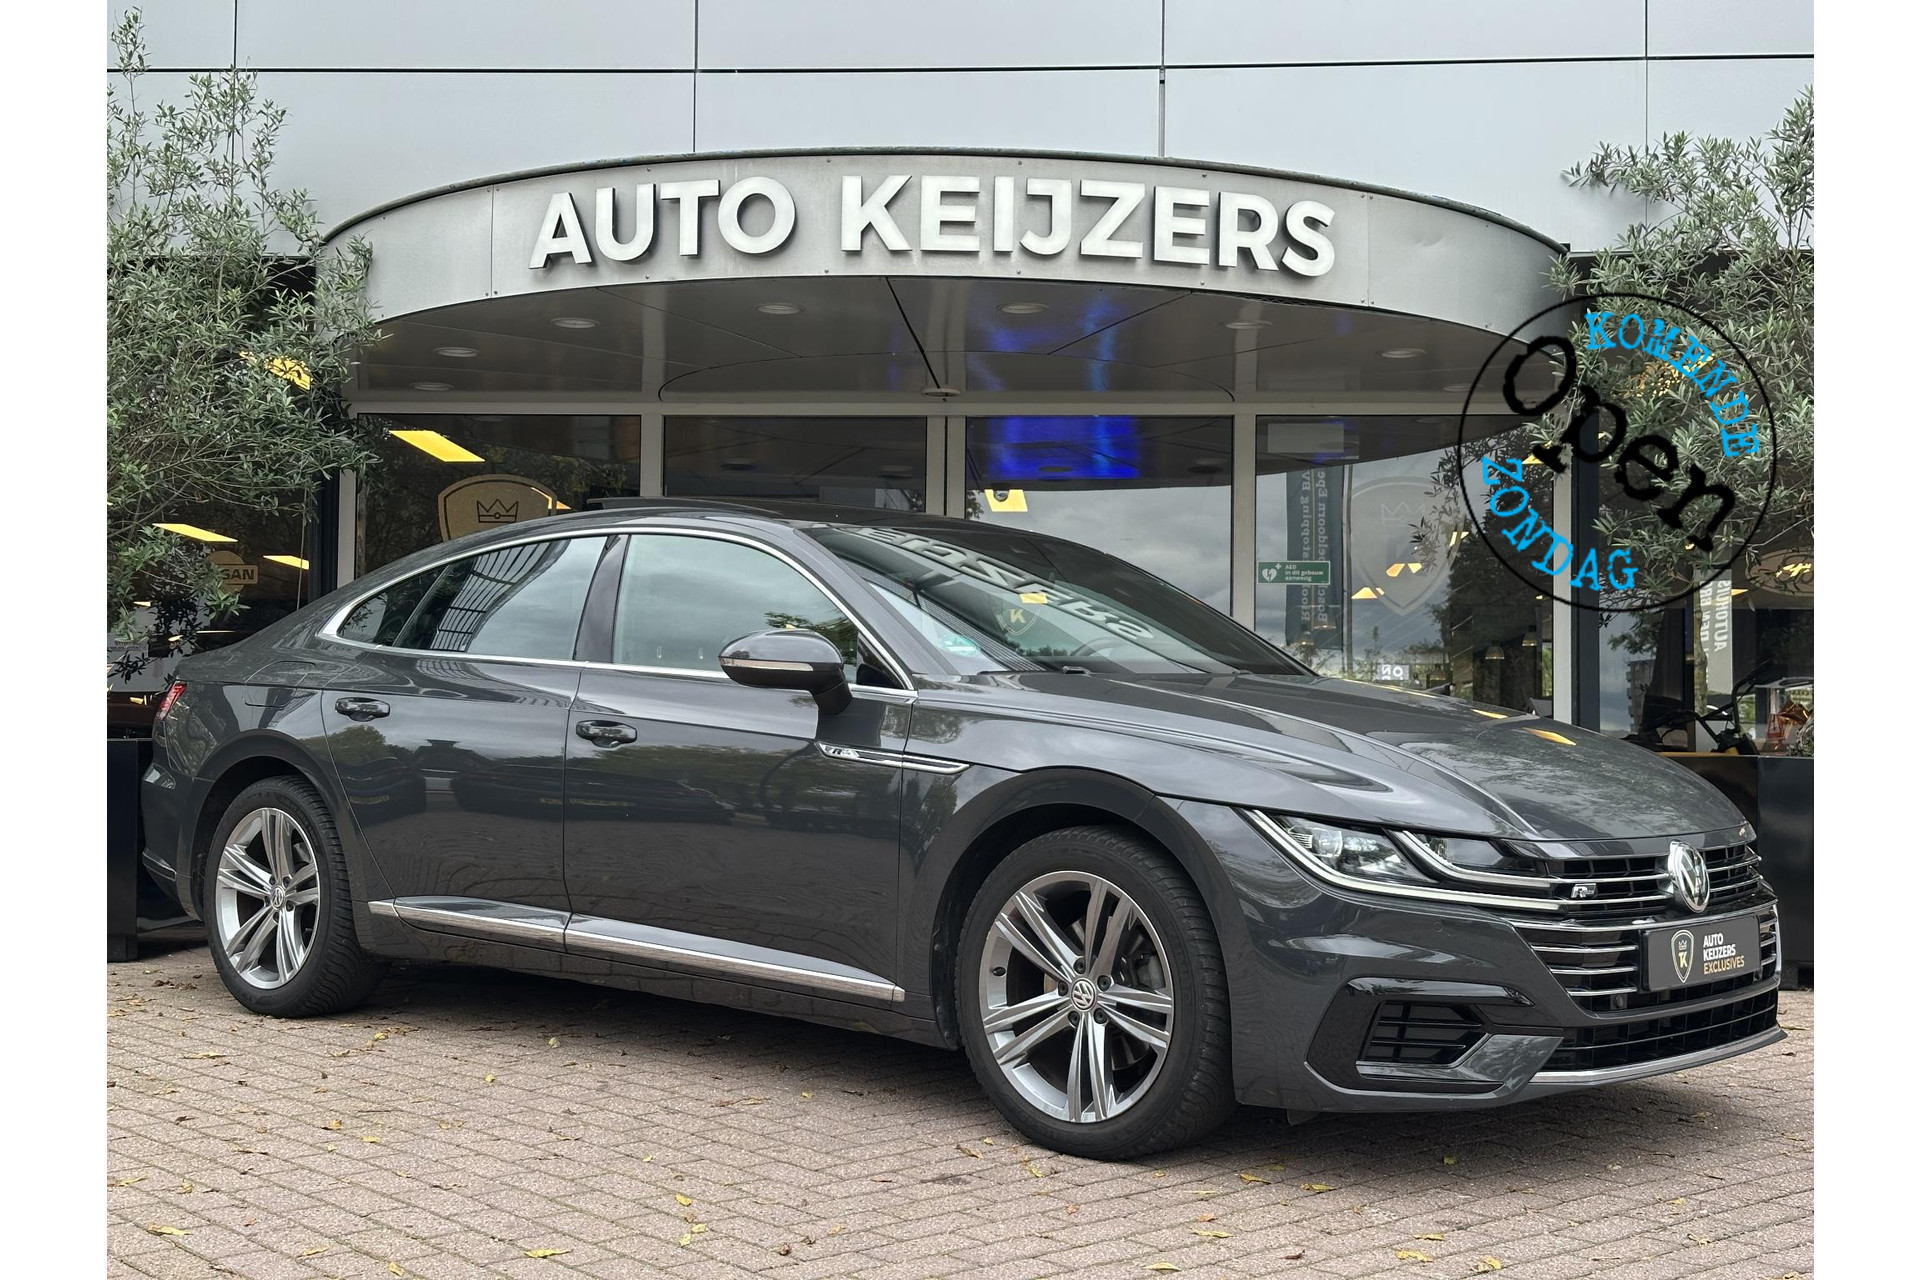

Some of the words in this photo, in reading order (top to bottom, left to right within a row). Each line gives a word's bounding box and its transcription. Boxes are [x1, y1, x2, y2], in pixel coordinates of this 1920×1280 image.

[528, 176, 796, 270] AUTO
[841, 174, 1337, 277] KEIJZERS
[1703, 932, 1724, 948] AUTO
[1703, 943, 1736, 962] KEIJZERS
[1703, 955, 1745, 975] EXCLUSIVES
